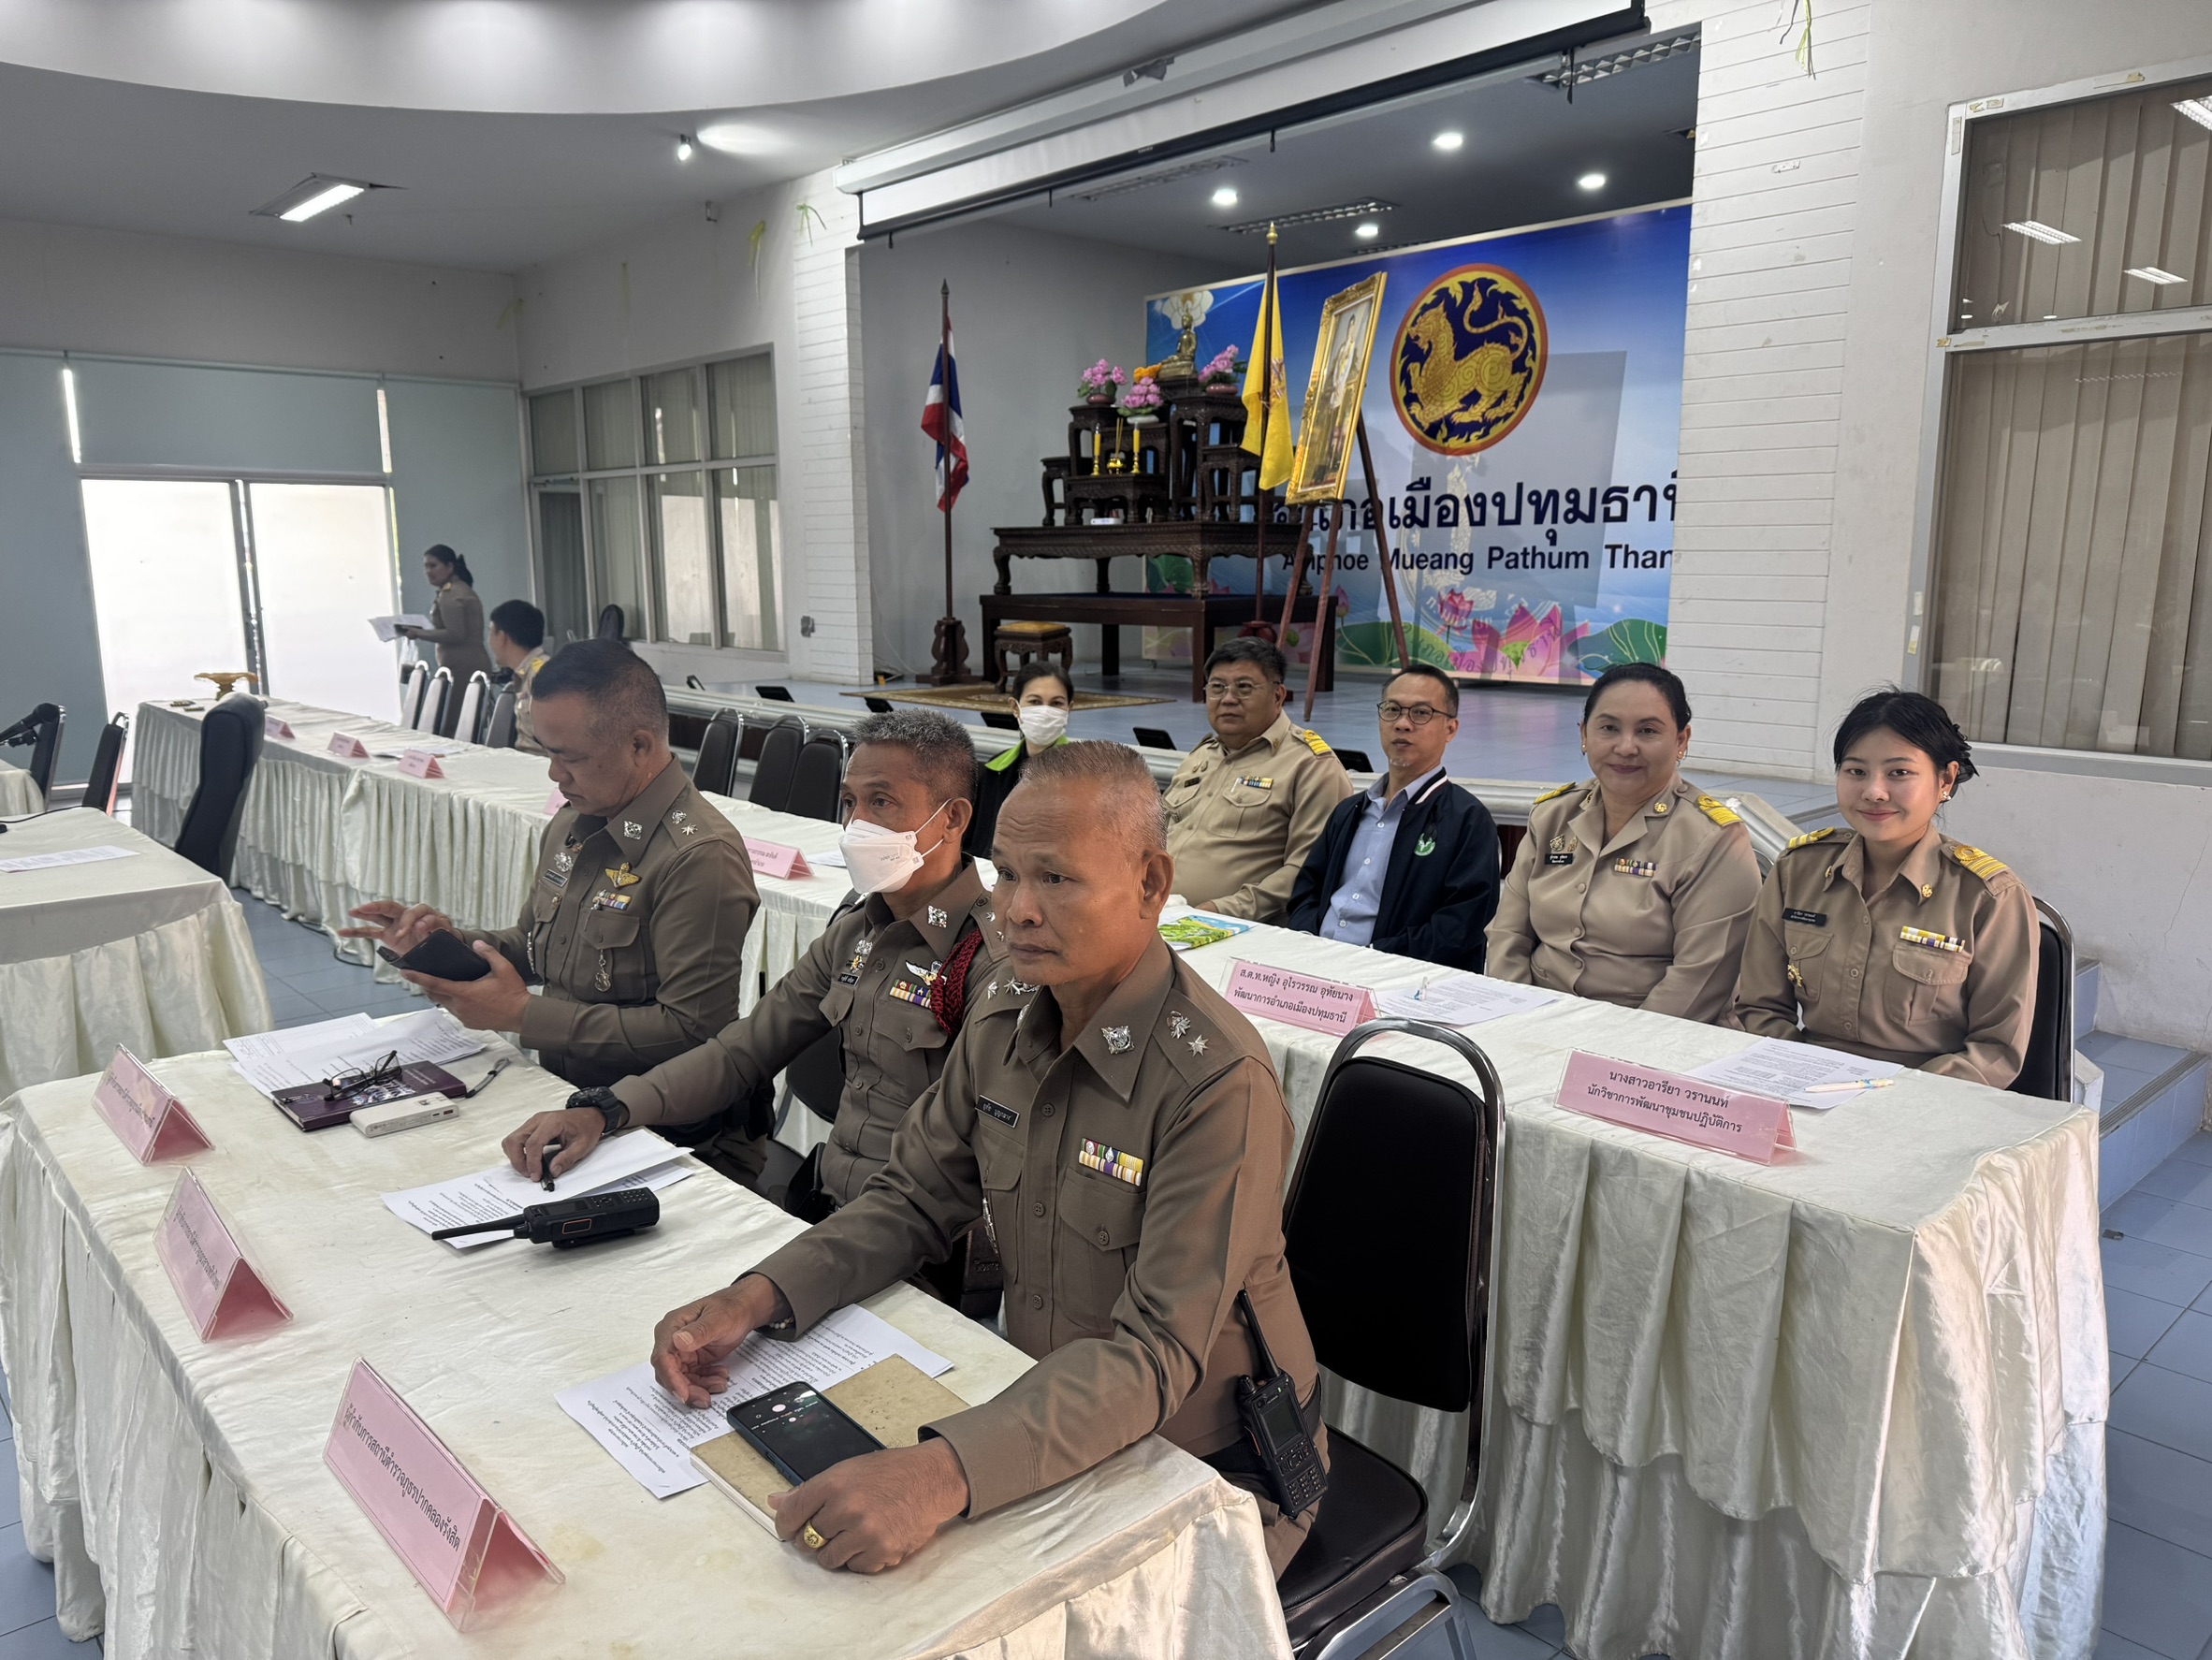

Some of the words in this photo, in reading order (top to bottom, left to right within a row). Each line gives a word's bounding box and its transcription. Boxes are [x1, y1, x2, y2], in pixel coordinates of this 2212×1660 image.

[1487, 546, 1590, 570] Pathum
[1233, 986, 1348, 1024] พัฒนาการอำเภอเมืองปทุมธานี
[1282, 976, 1318, 994] อุไรวรรณ
[1320, 985, 1354, 1002] อุทัยนาง
[1587, 1083, 1743, 1133] นักวิชาการพัฒนาชุมชนปฏิบัติการ
[1608, 1070, 1681, 1097] นางสาวอารียา
[1684, 1088, 1731, 1109] วรานนท์
